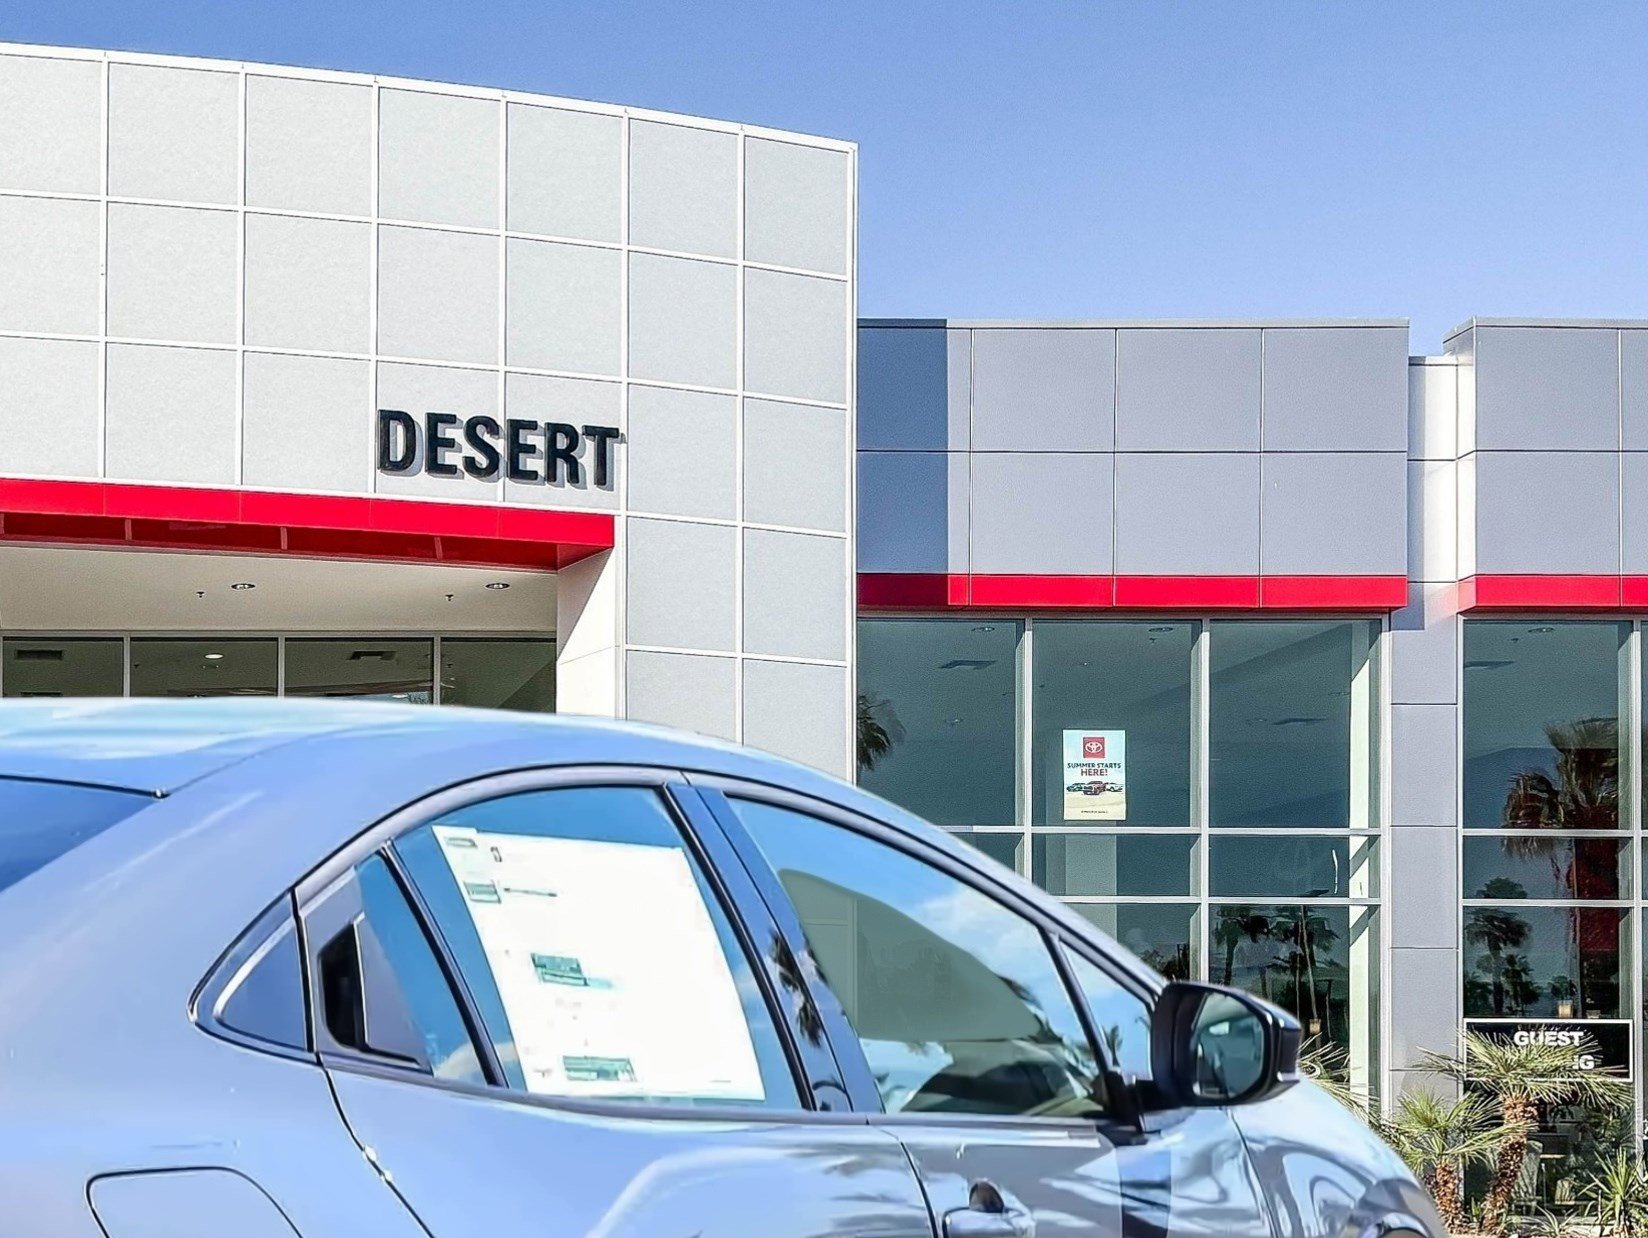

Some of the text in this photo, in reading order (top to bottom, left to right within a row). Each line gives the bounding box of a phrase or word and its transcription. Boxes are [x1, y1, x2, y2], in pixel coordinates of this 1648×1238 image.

[377, 409, 621, 487] DESERT
[1080, 768, 1108, 777] HERE!
[1513, 1031, 1585, 1047] GUEST
